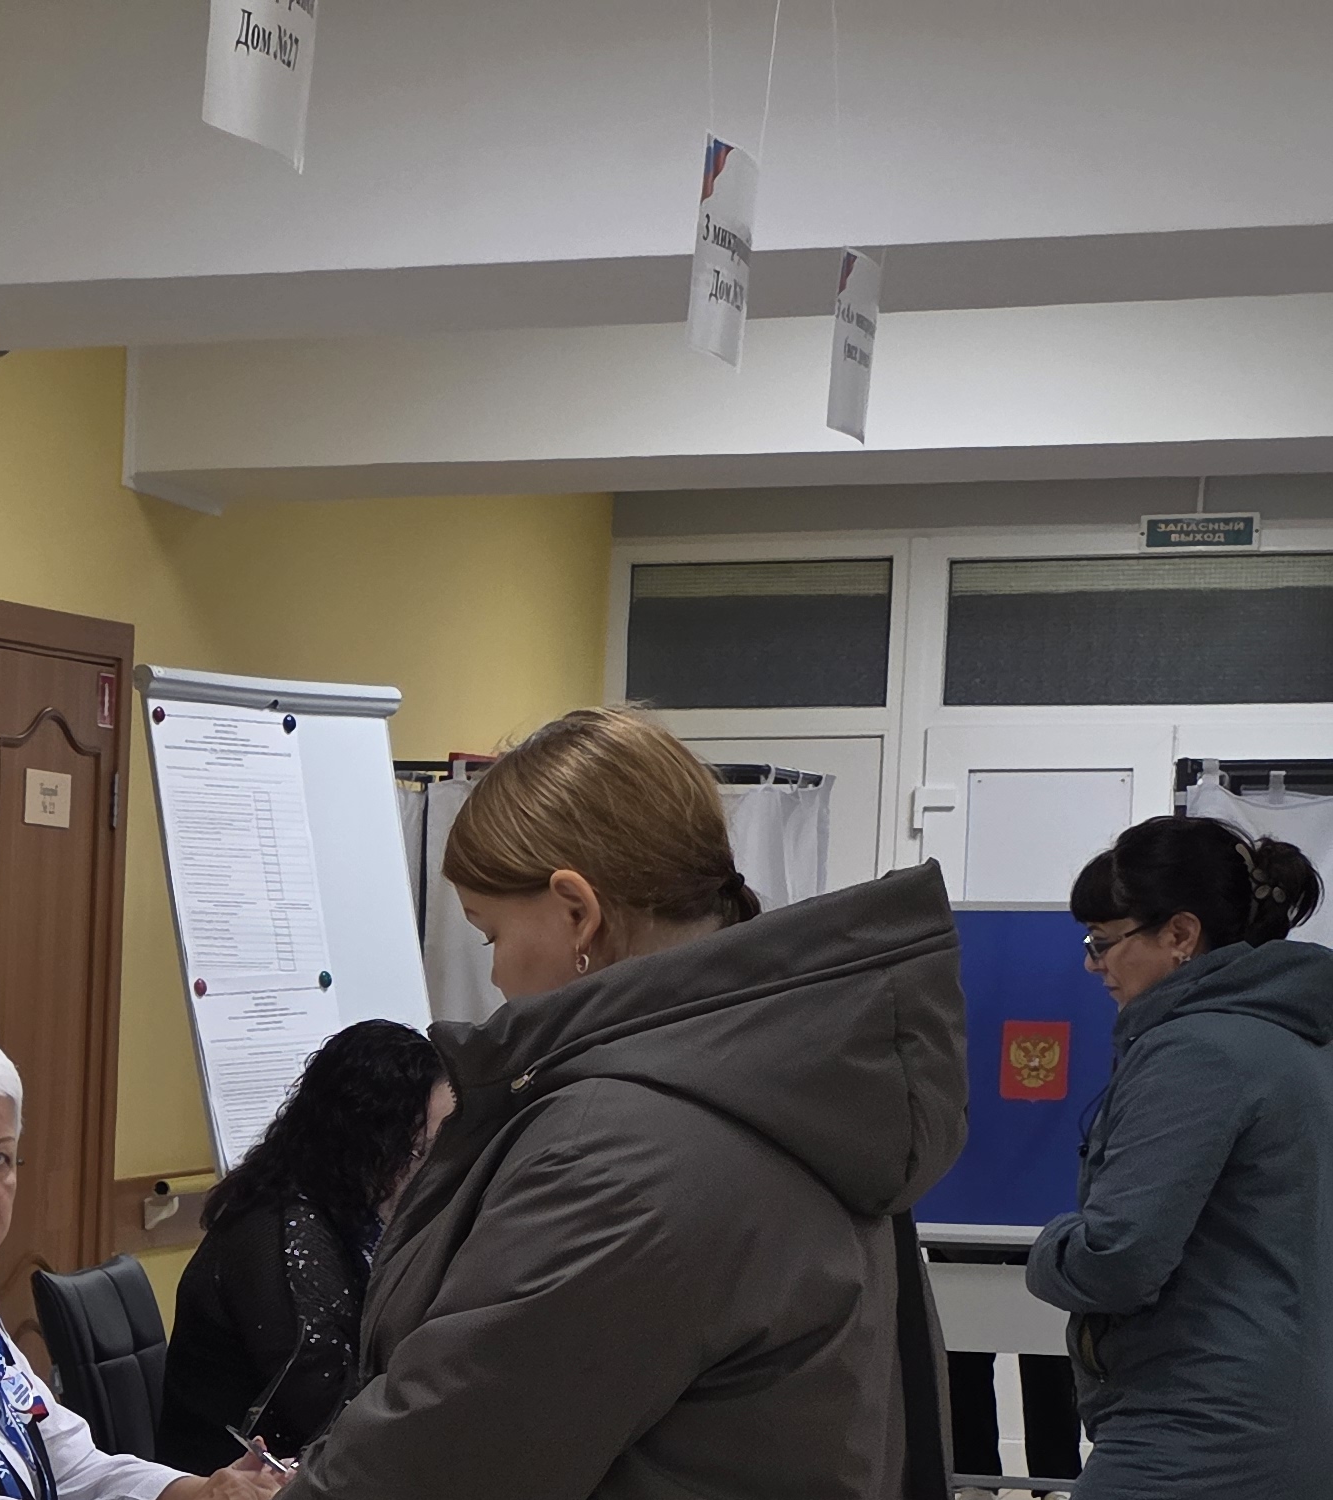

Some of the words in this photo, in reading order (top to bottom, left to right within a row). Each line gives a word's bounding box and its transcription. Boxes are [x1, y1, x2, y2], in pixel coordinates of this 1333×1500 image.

[234, 8, 272, 56] Дом
[1156, 520, 1245, 532] ЗАПАСНЫЙ
[1170, 533, 1225, 543] ВЫХОД
